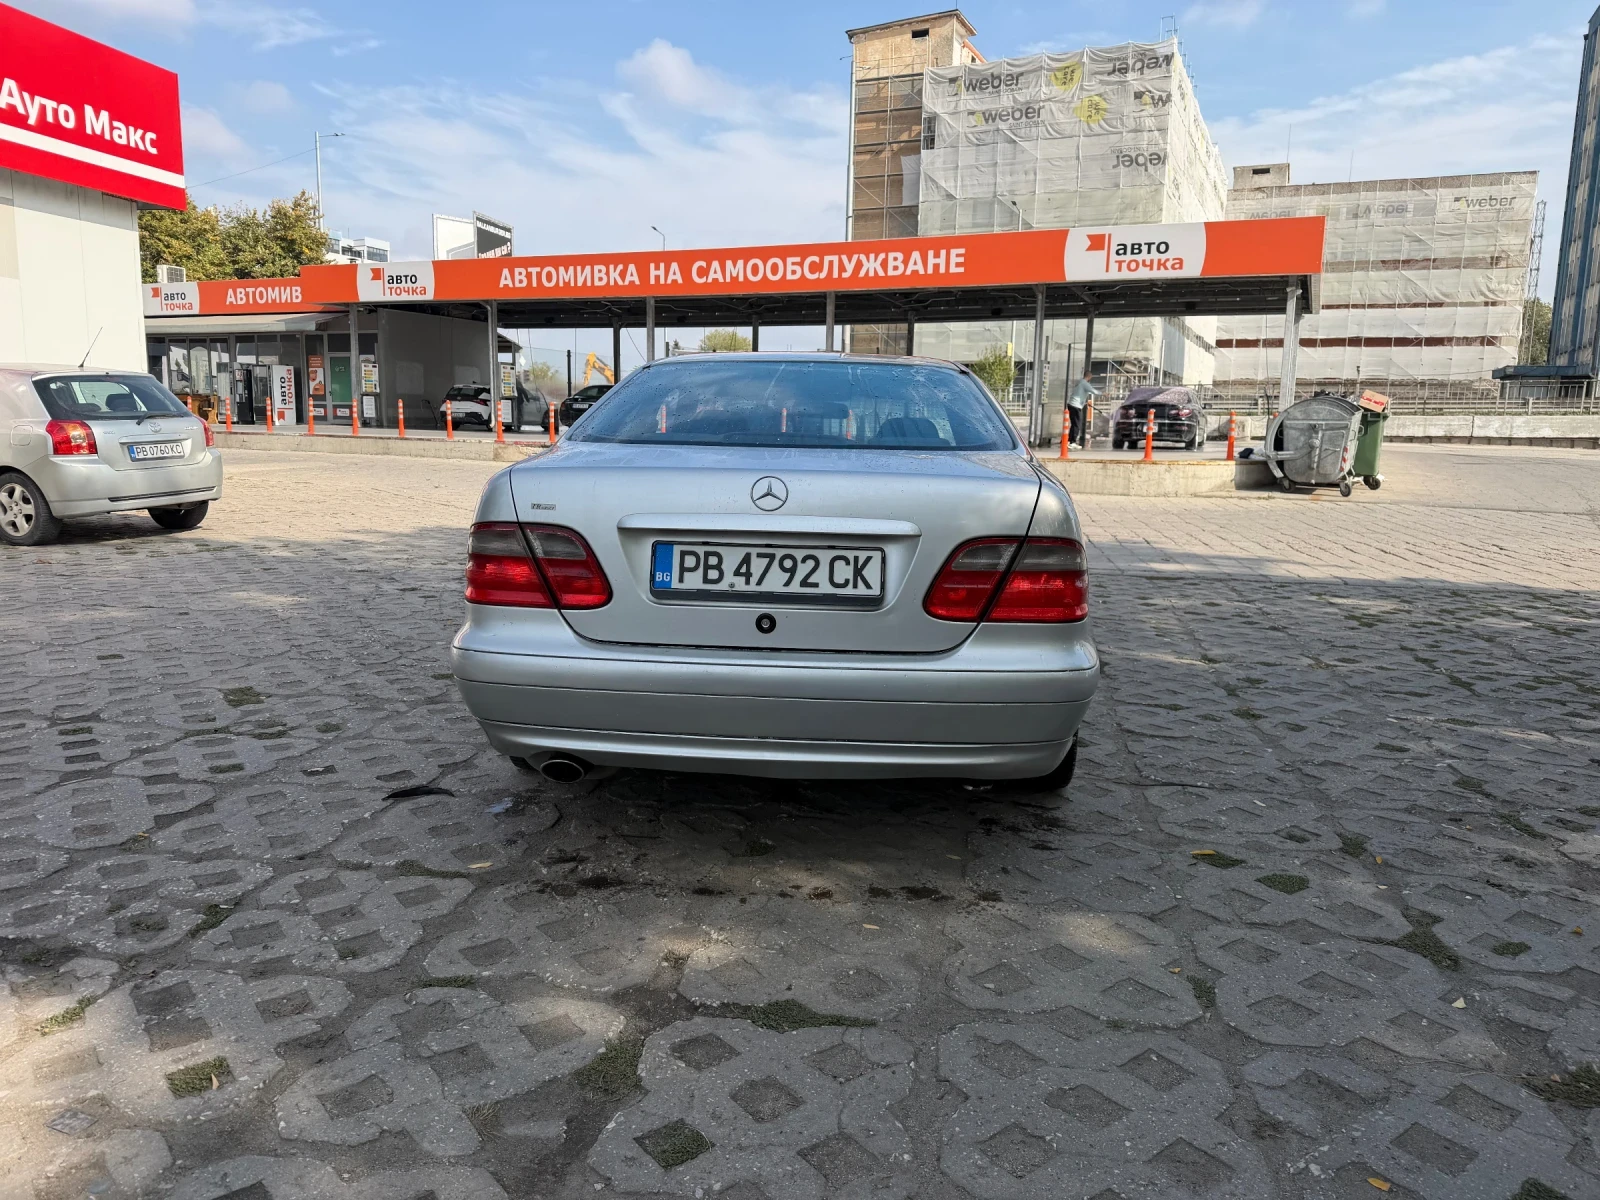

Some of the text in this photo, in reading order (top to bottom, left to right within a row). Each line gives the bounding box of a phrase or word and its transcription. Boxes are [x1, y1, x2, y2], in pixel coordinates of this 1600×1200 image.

[964, 72, 1024, 92] weber
[0, 78, 158, 155] Ауто Макс
[982, 105, 1045, 124] weber
[1465, 195, 1516, 208] weber
[1115, 241, 1170, 256] авто
[499, 248, 966, 288] АВТОМИВКА НА САМООБСЛУЖВАНЕ
[1114, 257, 1184, 273] точка
[387, 274, 418, 285] авто
[163, 291, 186, 301] авто
[226, 286, 302, 305] АВТОМИВ
[388, 286, 427, 296] точка
[164, 302, 193, 311] точка
[286, 368, 294, 405] точка
[149, 445, 169, 456] 0760
[655, 571, 671, 582] BG
[678, 550, 873, 590] PB 4792 CK
